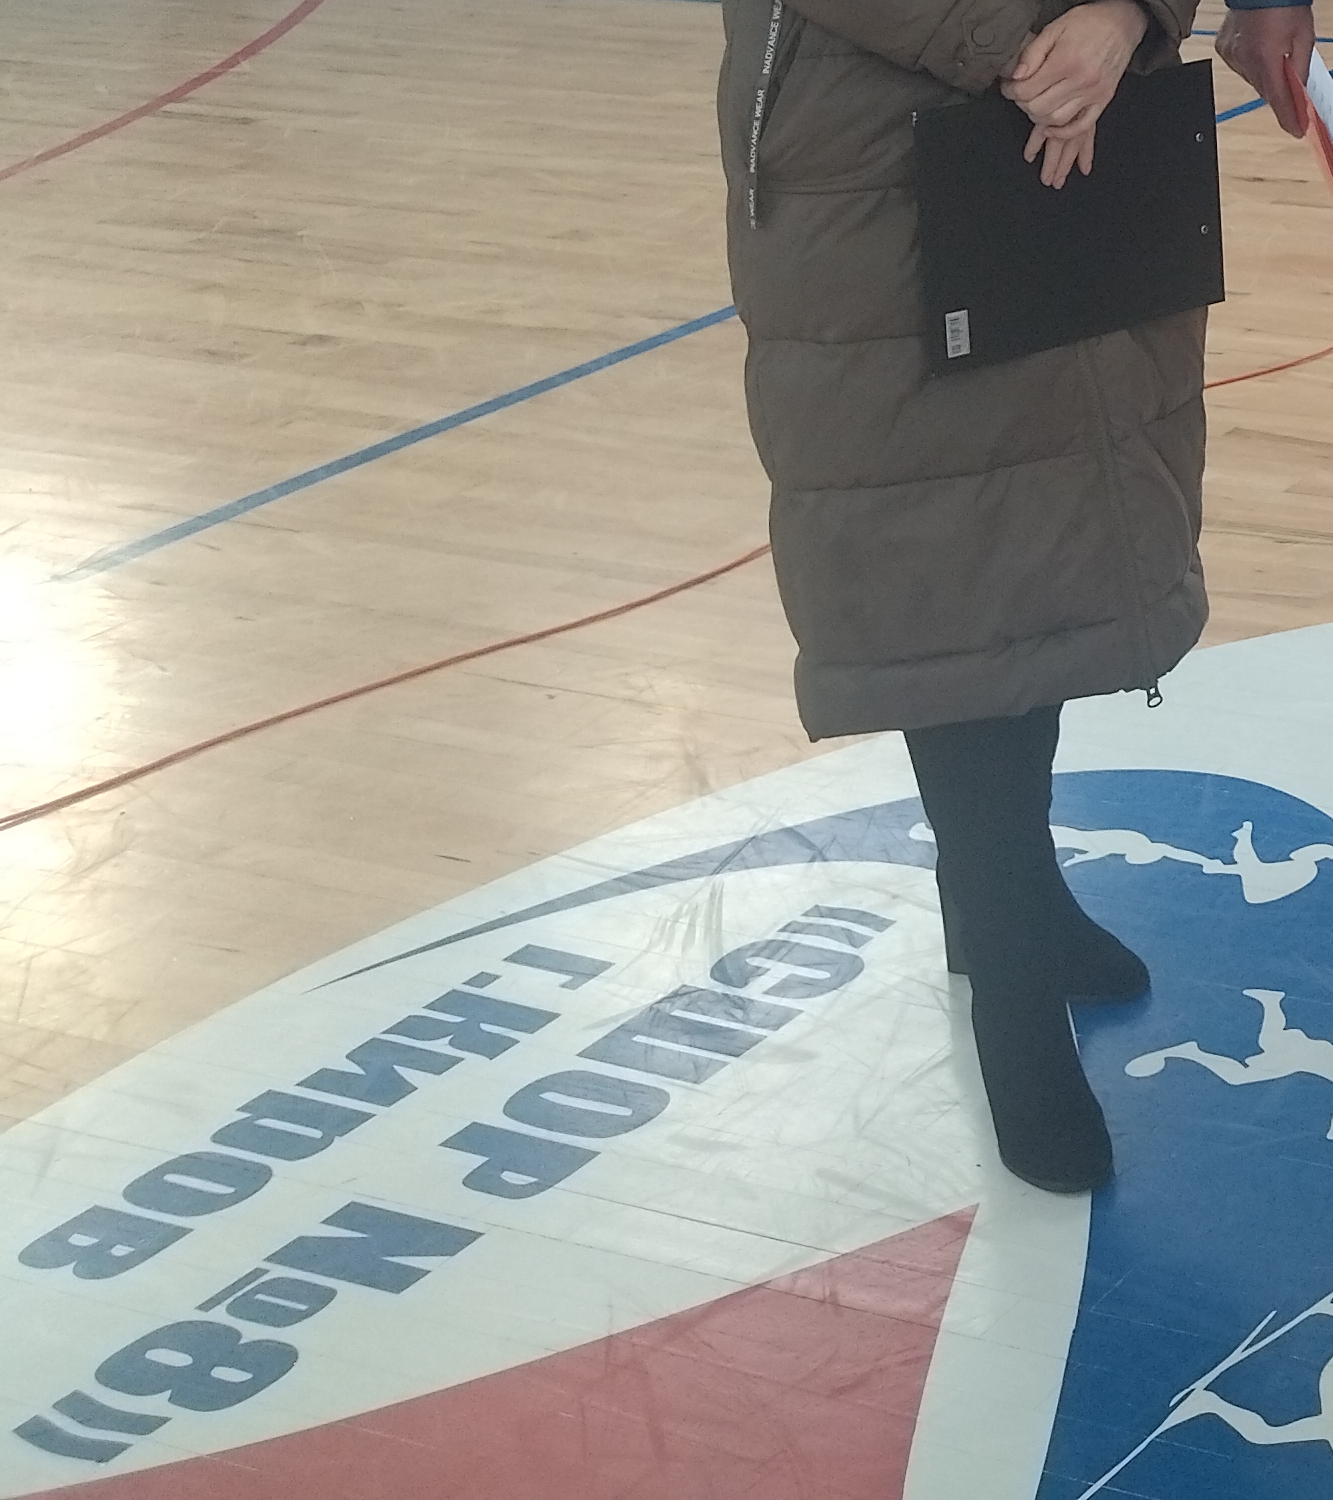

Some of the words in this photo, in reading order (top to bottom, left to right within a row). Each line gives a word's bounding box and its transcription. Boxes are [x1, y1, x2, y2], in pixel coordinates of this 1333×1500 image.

[762, 21, 779, 74] INADVANCE
[754, 89, 765, 118] WEAR
[749, 120, 760, 173] INADVANCE
